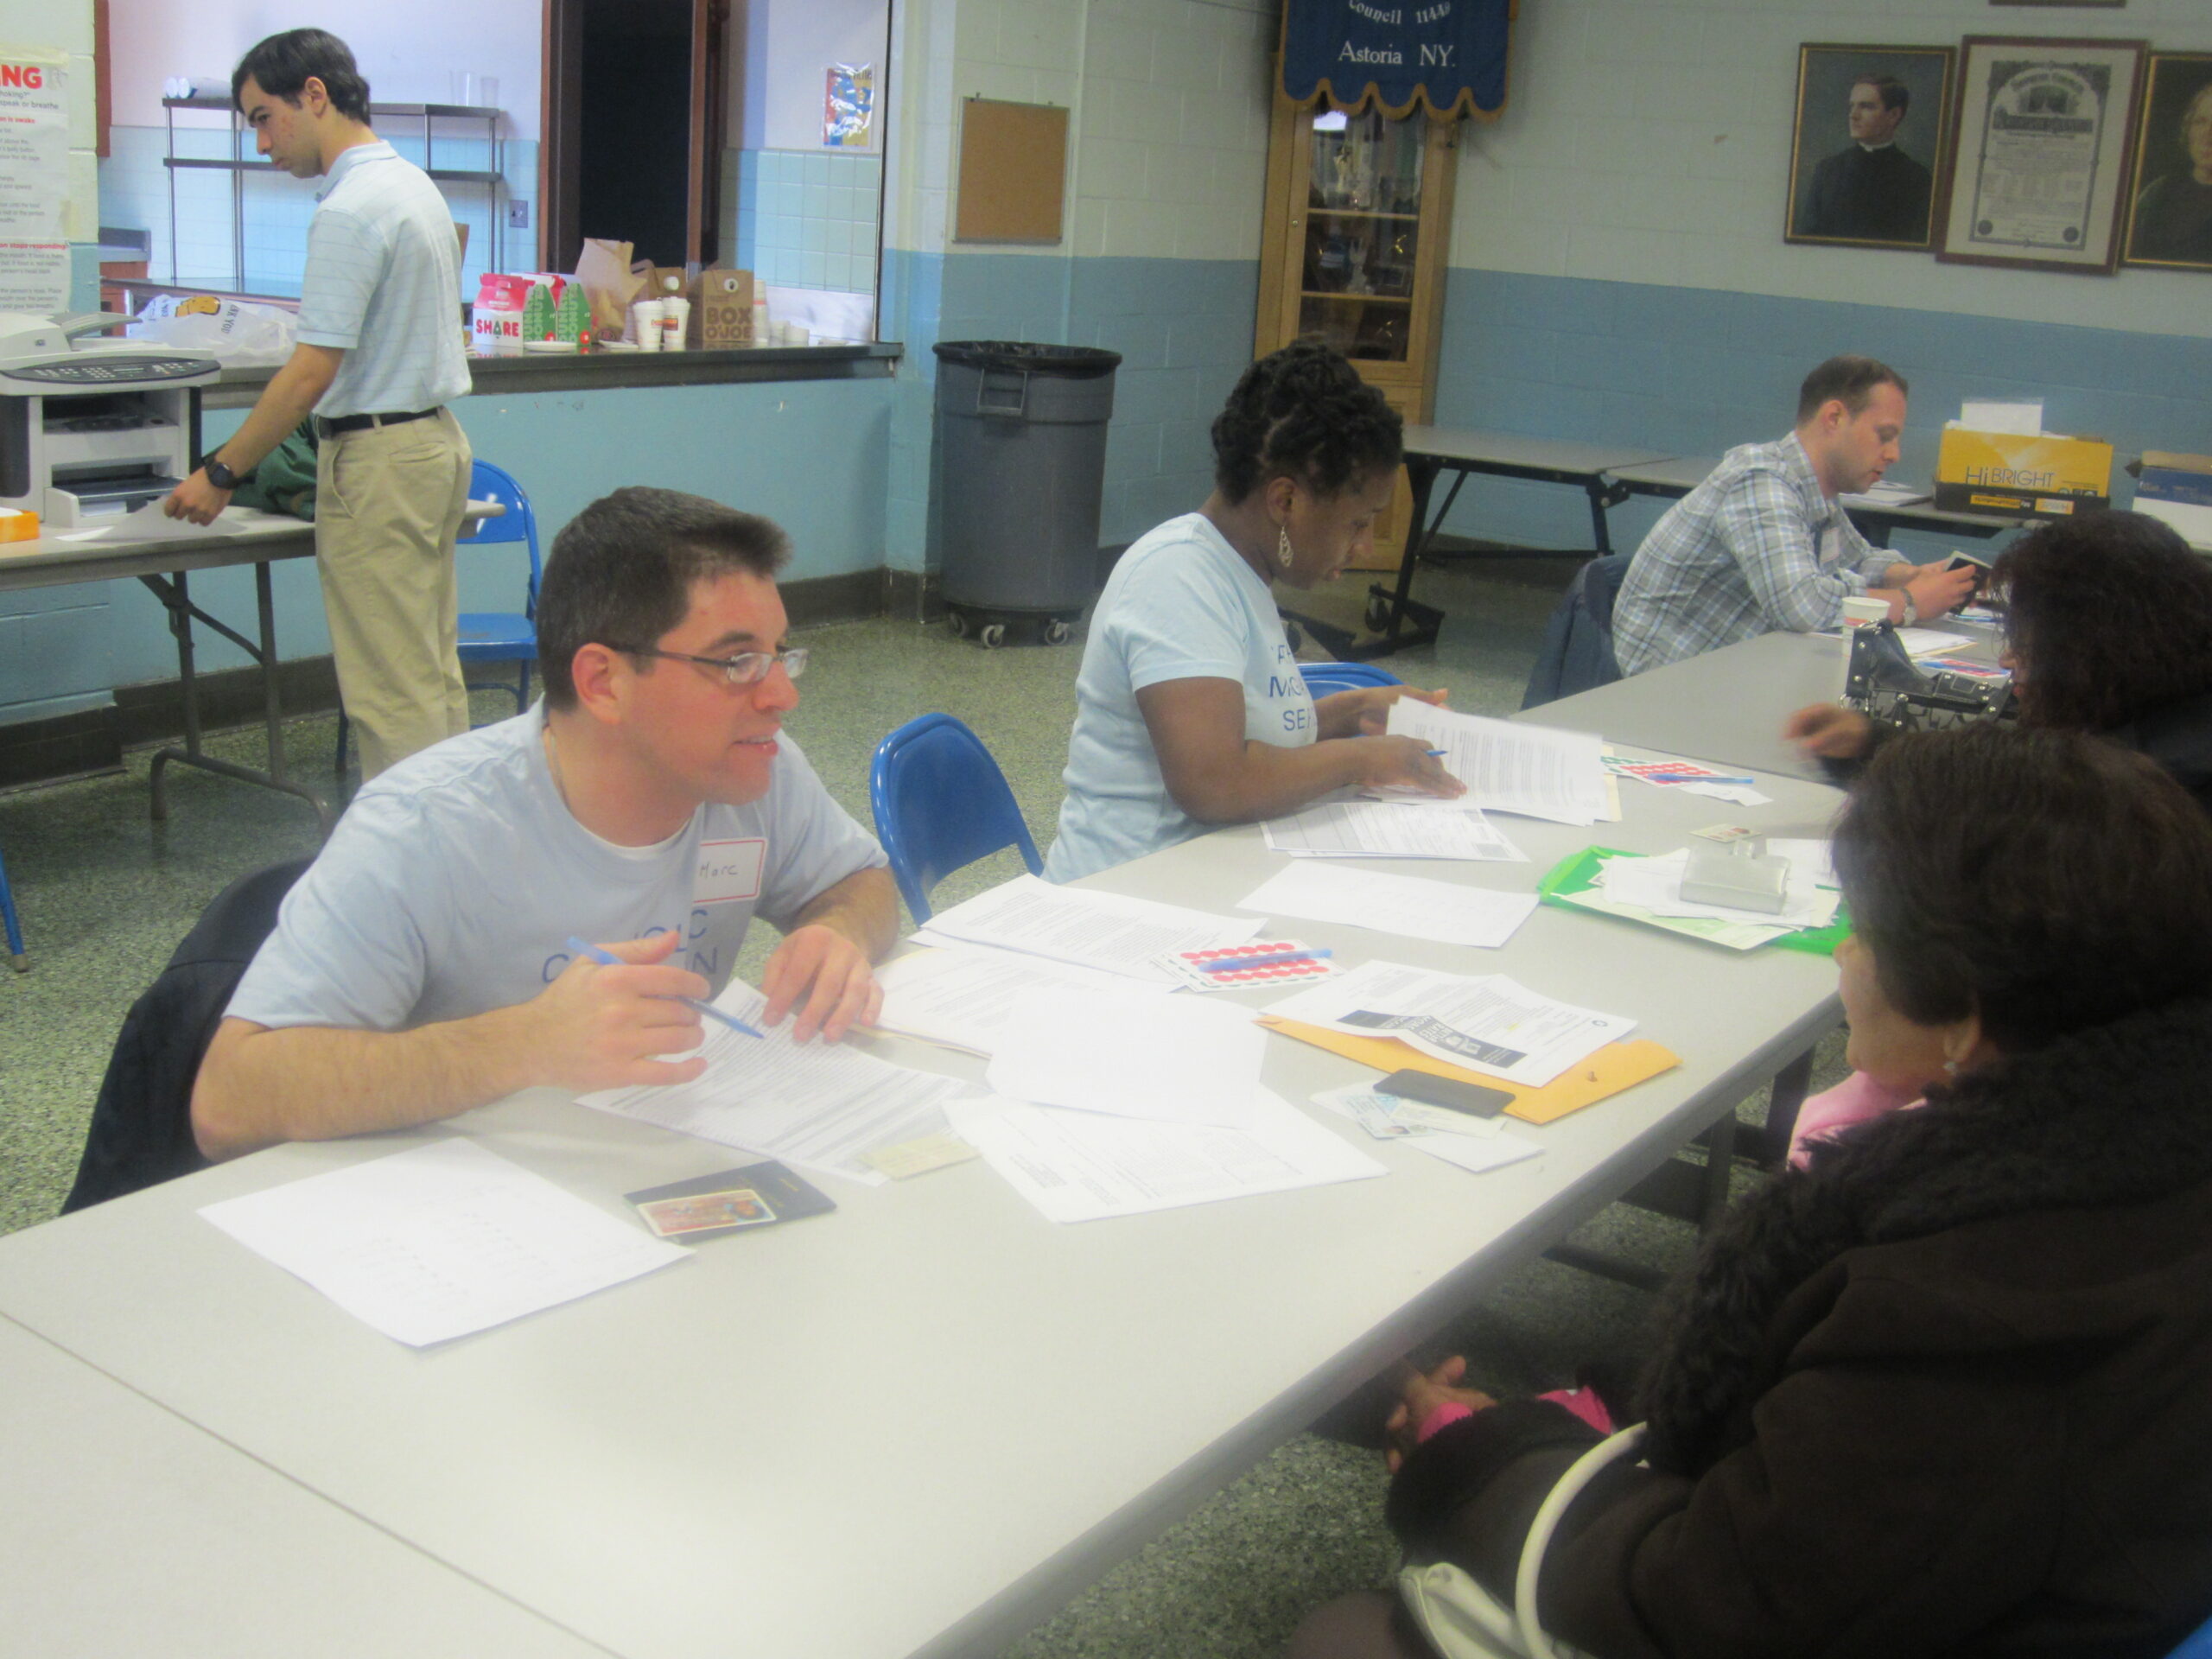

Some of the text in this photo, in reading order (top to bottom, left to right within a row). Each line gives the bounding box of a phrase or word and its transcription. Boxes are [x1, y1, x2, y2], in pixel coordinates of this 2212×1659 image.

[1349, 0, 1402, 24] Council
[1338, 41, 1456, 67] Astoria NY.
[0, 64, 42, 90] NG
[476, 318, 519, 337] SHARE
[706, 307, 751, 325] BOX
